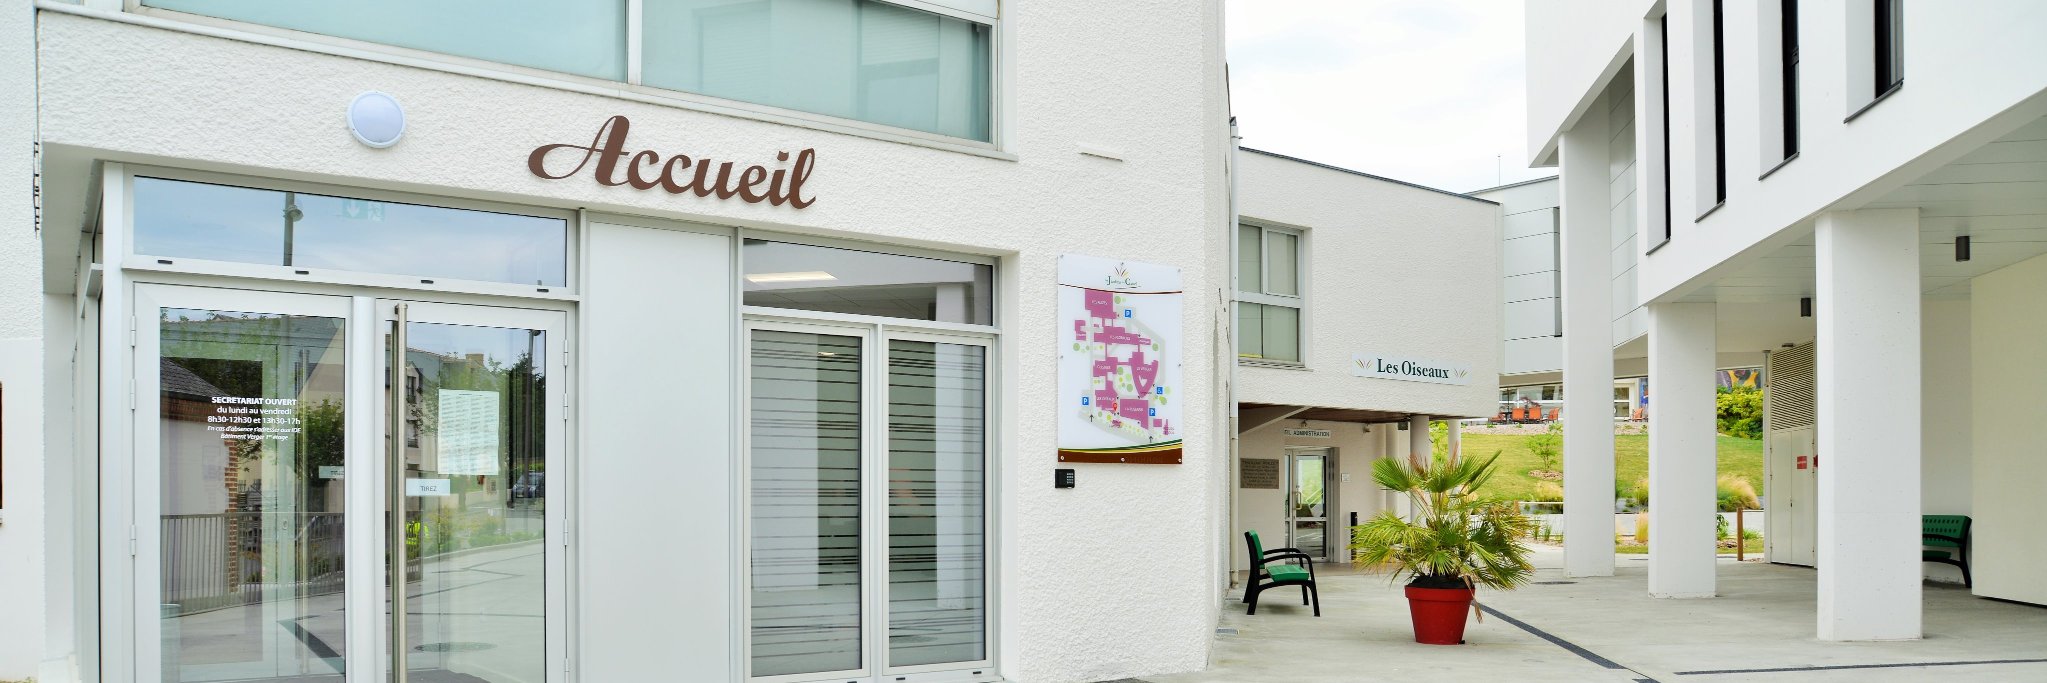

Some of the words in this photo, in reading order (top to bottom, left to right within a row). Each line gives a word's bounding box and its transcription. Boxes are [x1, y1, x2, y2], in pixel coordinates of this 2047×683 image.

[527, 114, 817, 210] Accueil
[1377, 358, 1399, 375] Les
[1401, 360, 1450, 379] Oiseaux
[211, 396, 263, 405] SECRETARIAT
[264, 398, 297, 406] OUVERT
[216, 406, 227, 414] du
[228, 406, 248, 415] lundi
[260, 407, 292, 415] vendredi
[207, 415, 252, 424] 8h30-12h30
[262, 417, 301, 425] 13h30-17h
